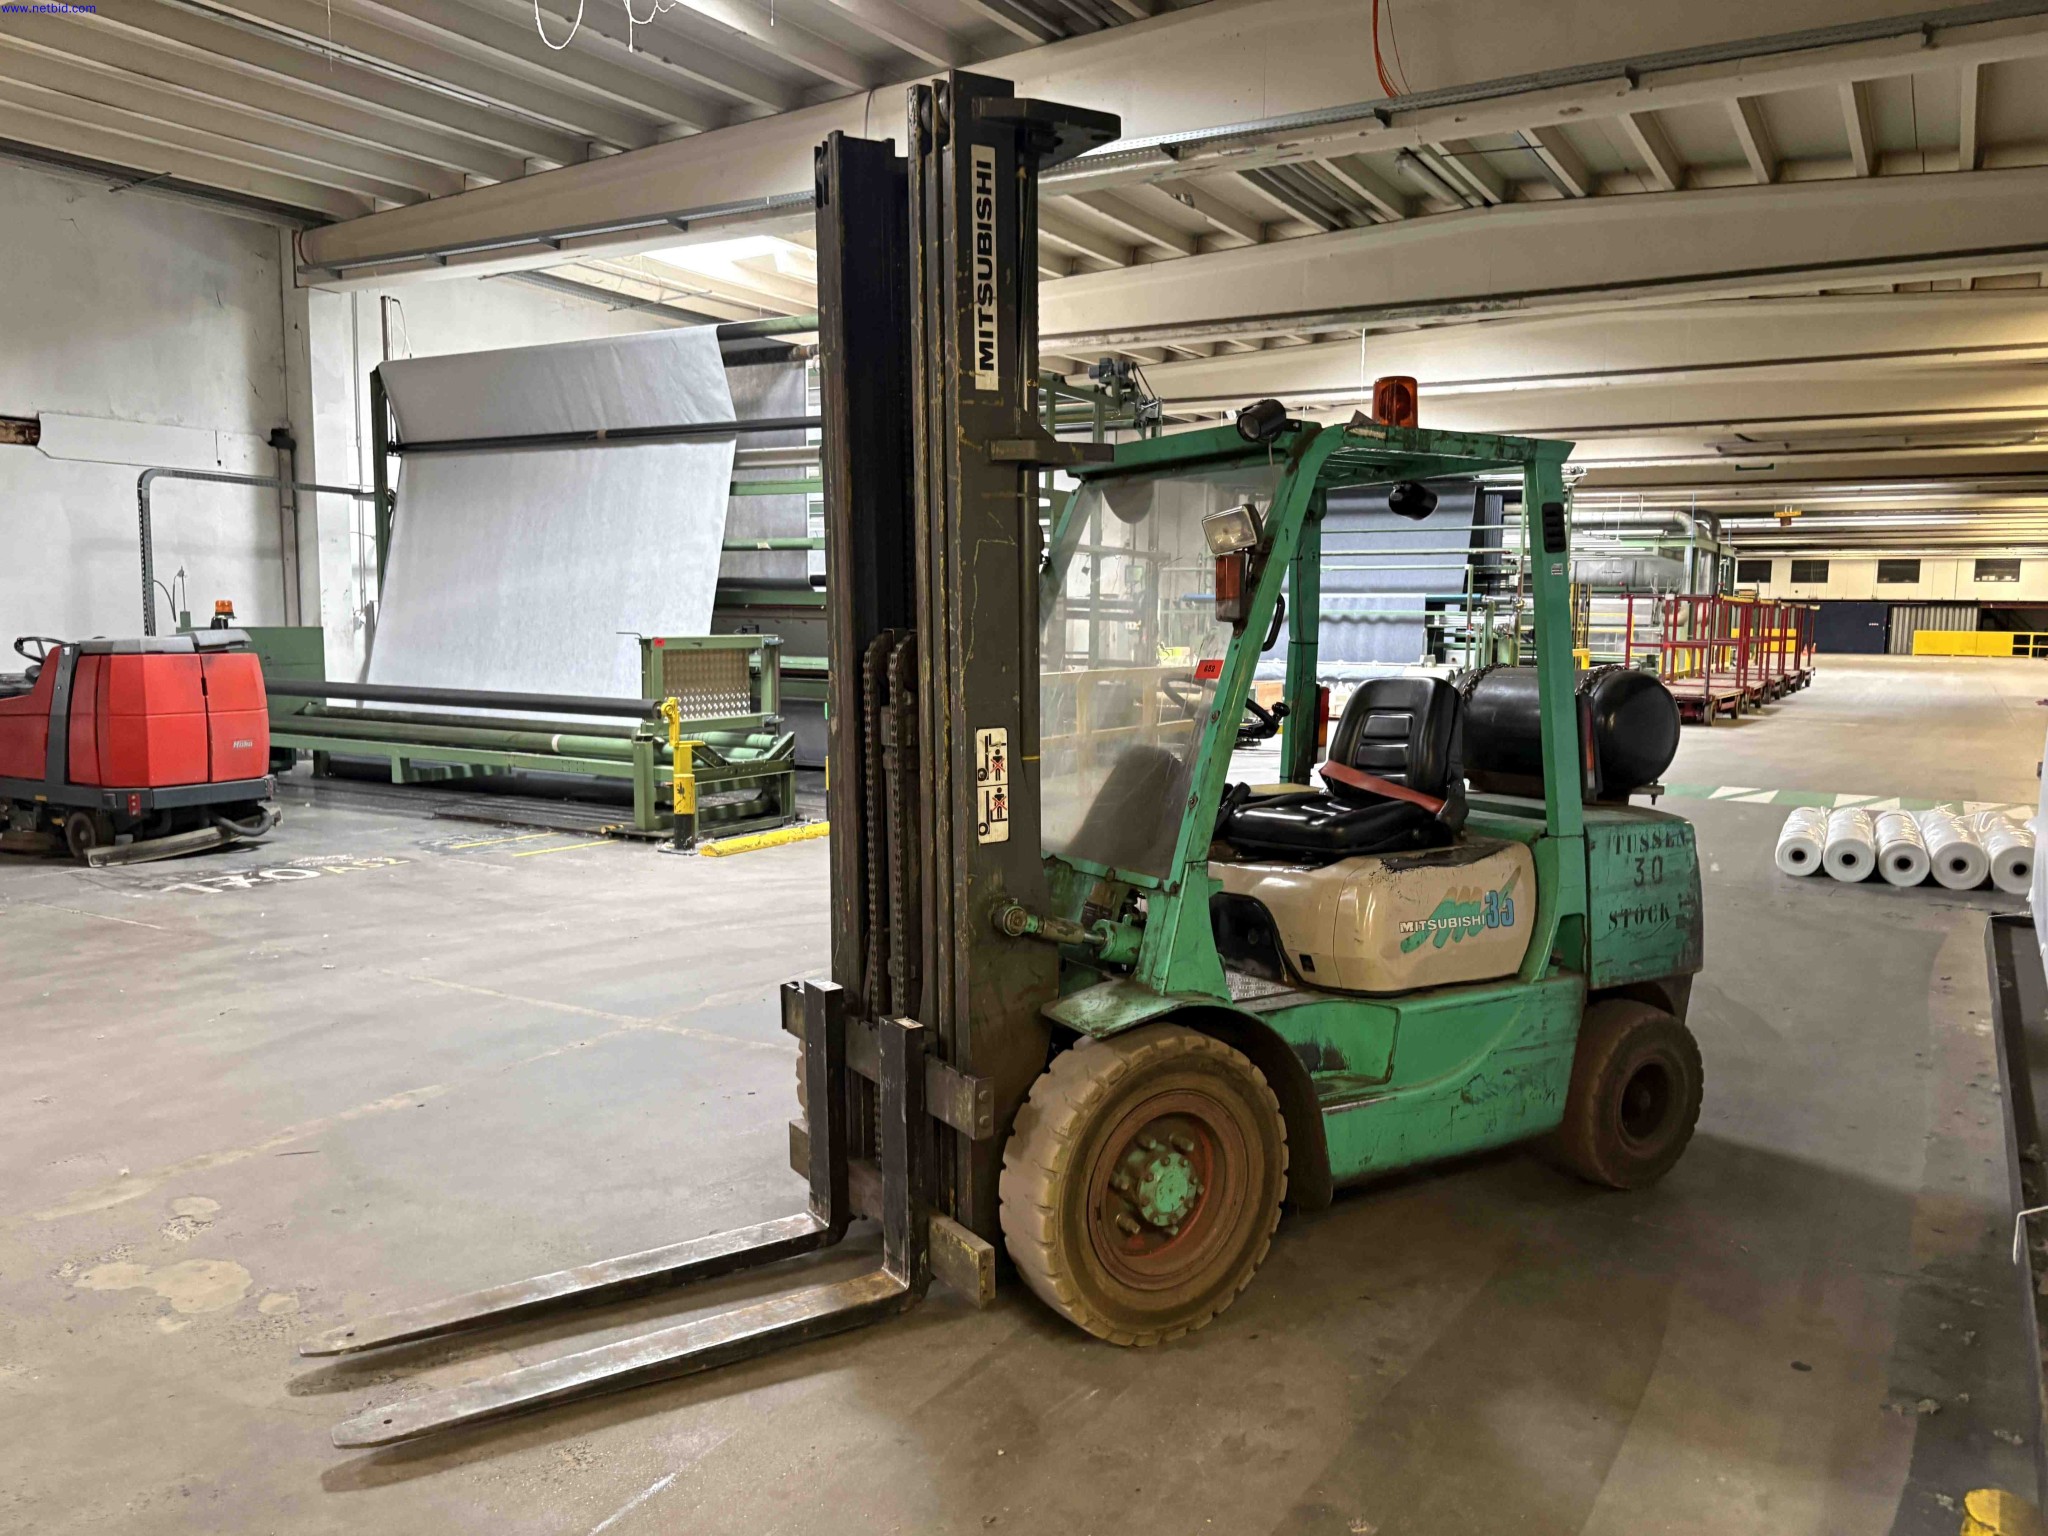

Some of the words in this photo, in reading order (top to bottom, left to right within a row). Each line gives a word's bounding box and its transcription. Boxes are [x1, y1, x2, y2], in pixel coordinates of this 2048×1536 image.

[976, 160, 995, 371] MITSUBISHI
[1634, 855, 1664, 888] 30
[1399, 915, 1486, 934] MITSUBISHI
[1608, 903, 1671, 931] STOCK
